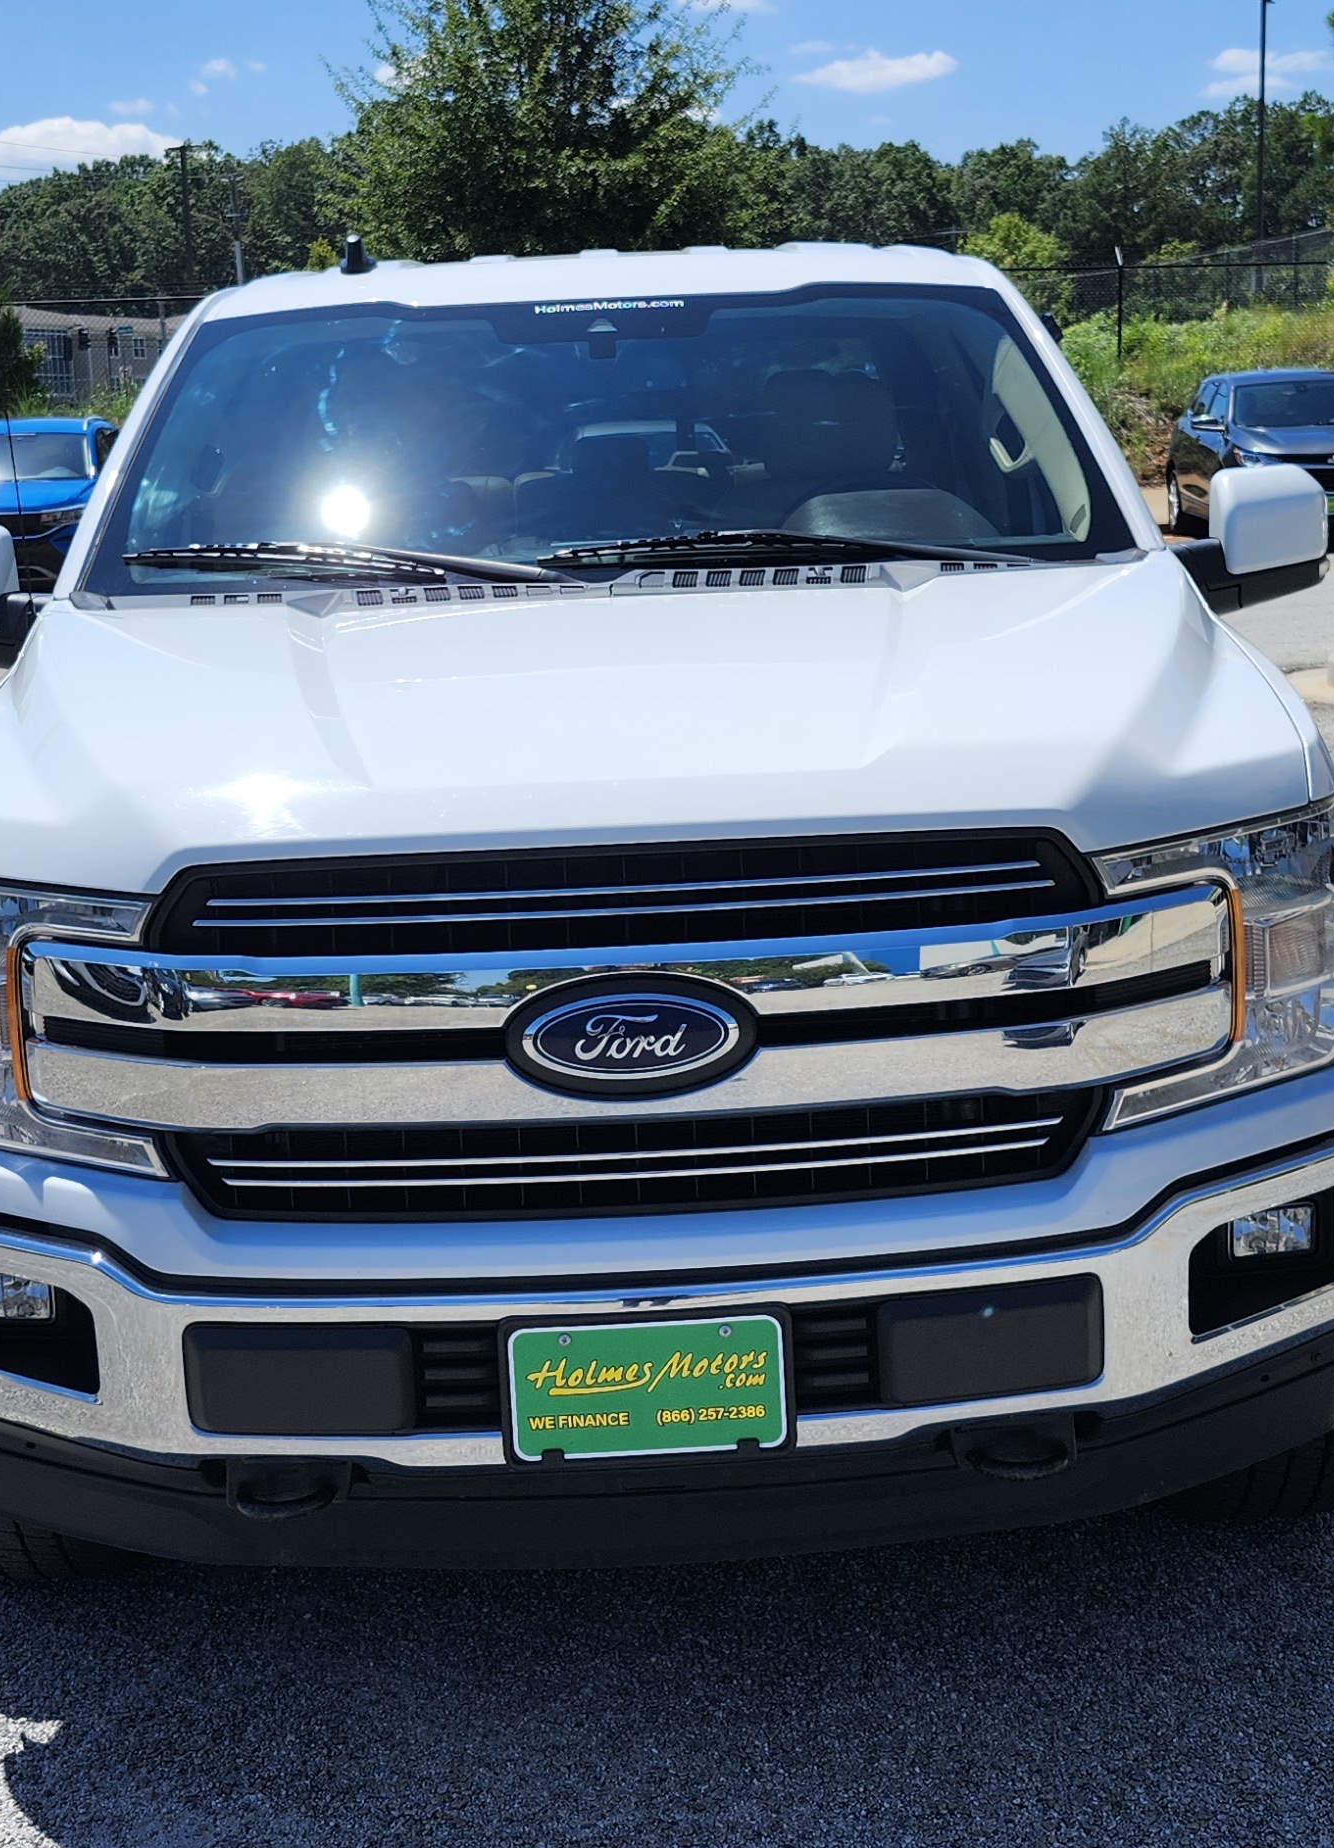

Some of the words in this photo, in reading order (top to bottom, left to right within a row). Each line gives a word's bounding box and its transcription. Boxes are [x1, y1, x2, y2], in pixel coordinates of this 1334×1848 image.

[534, 300, 685, 315] HolmesMotors.com
[574, 1014, 687, 1061] Ford
[526, 1357, 654, 1396] Holmes
[646, 1350, 768, 1393] Motors
[718, 1371, 766, 1390] .com
[528, 1416, 555, 1431] WE
[558, 1411, 630, 1429] FINANCE
[656, 1408, 696, 1427] (866)
[698, 1404, 766, 1423] 257-2386
